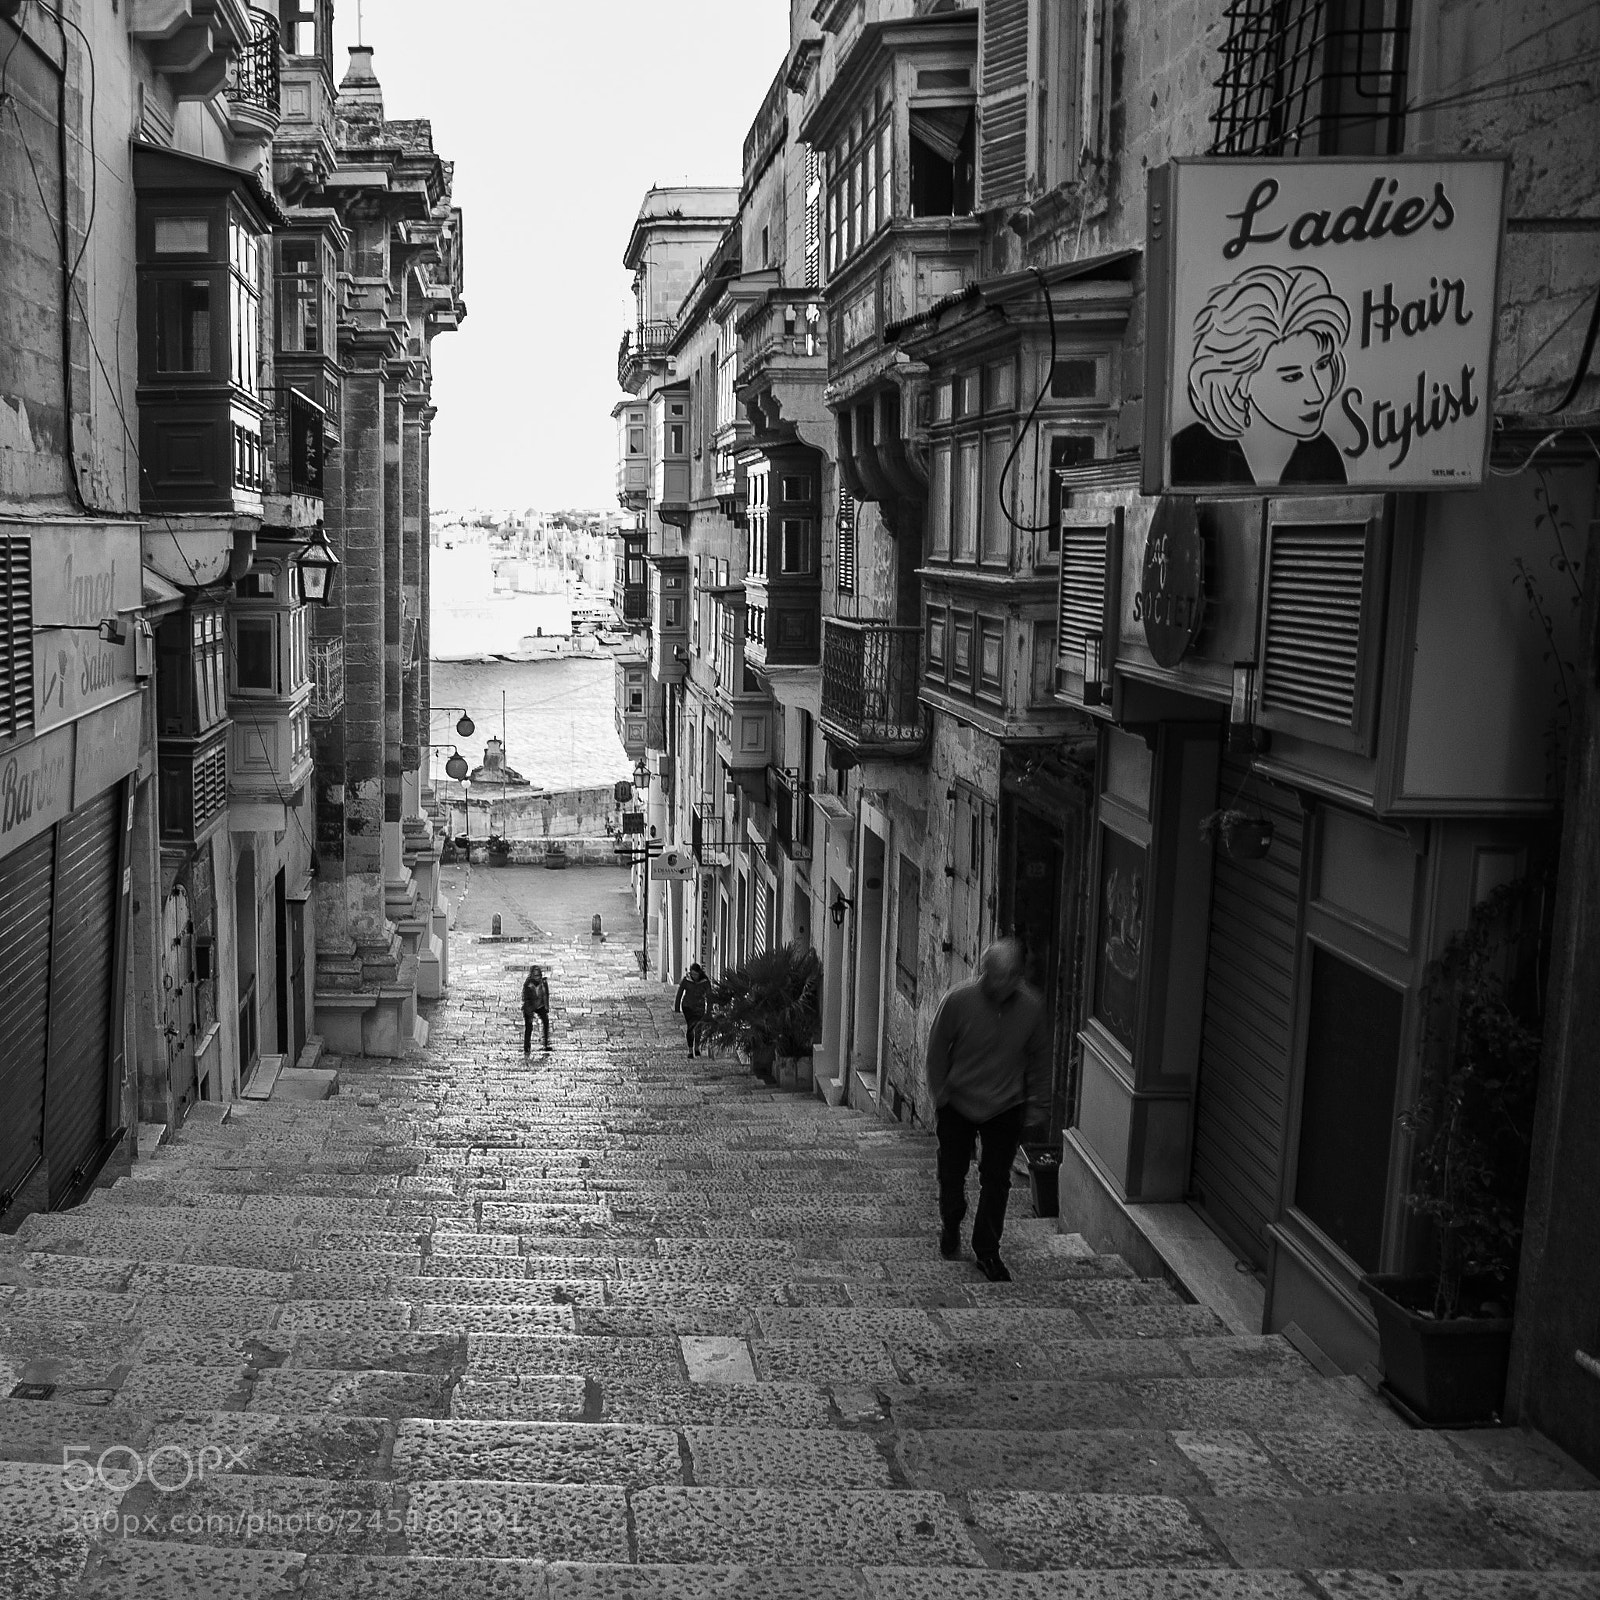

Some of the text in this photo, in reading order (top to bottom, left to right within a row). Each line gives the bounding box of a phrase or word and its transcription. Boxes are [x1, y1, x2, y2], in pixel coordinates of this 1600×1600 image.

[1223, 177, 1455, 260] Ladies
[1361, 276, 1473, 349] Hair
[1342, 363, 1479, 469] Stylist
[81, 640, 115, 696] Salon
[2, 747, 64, 834] Barber
